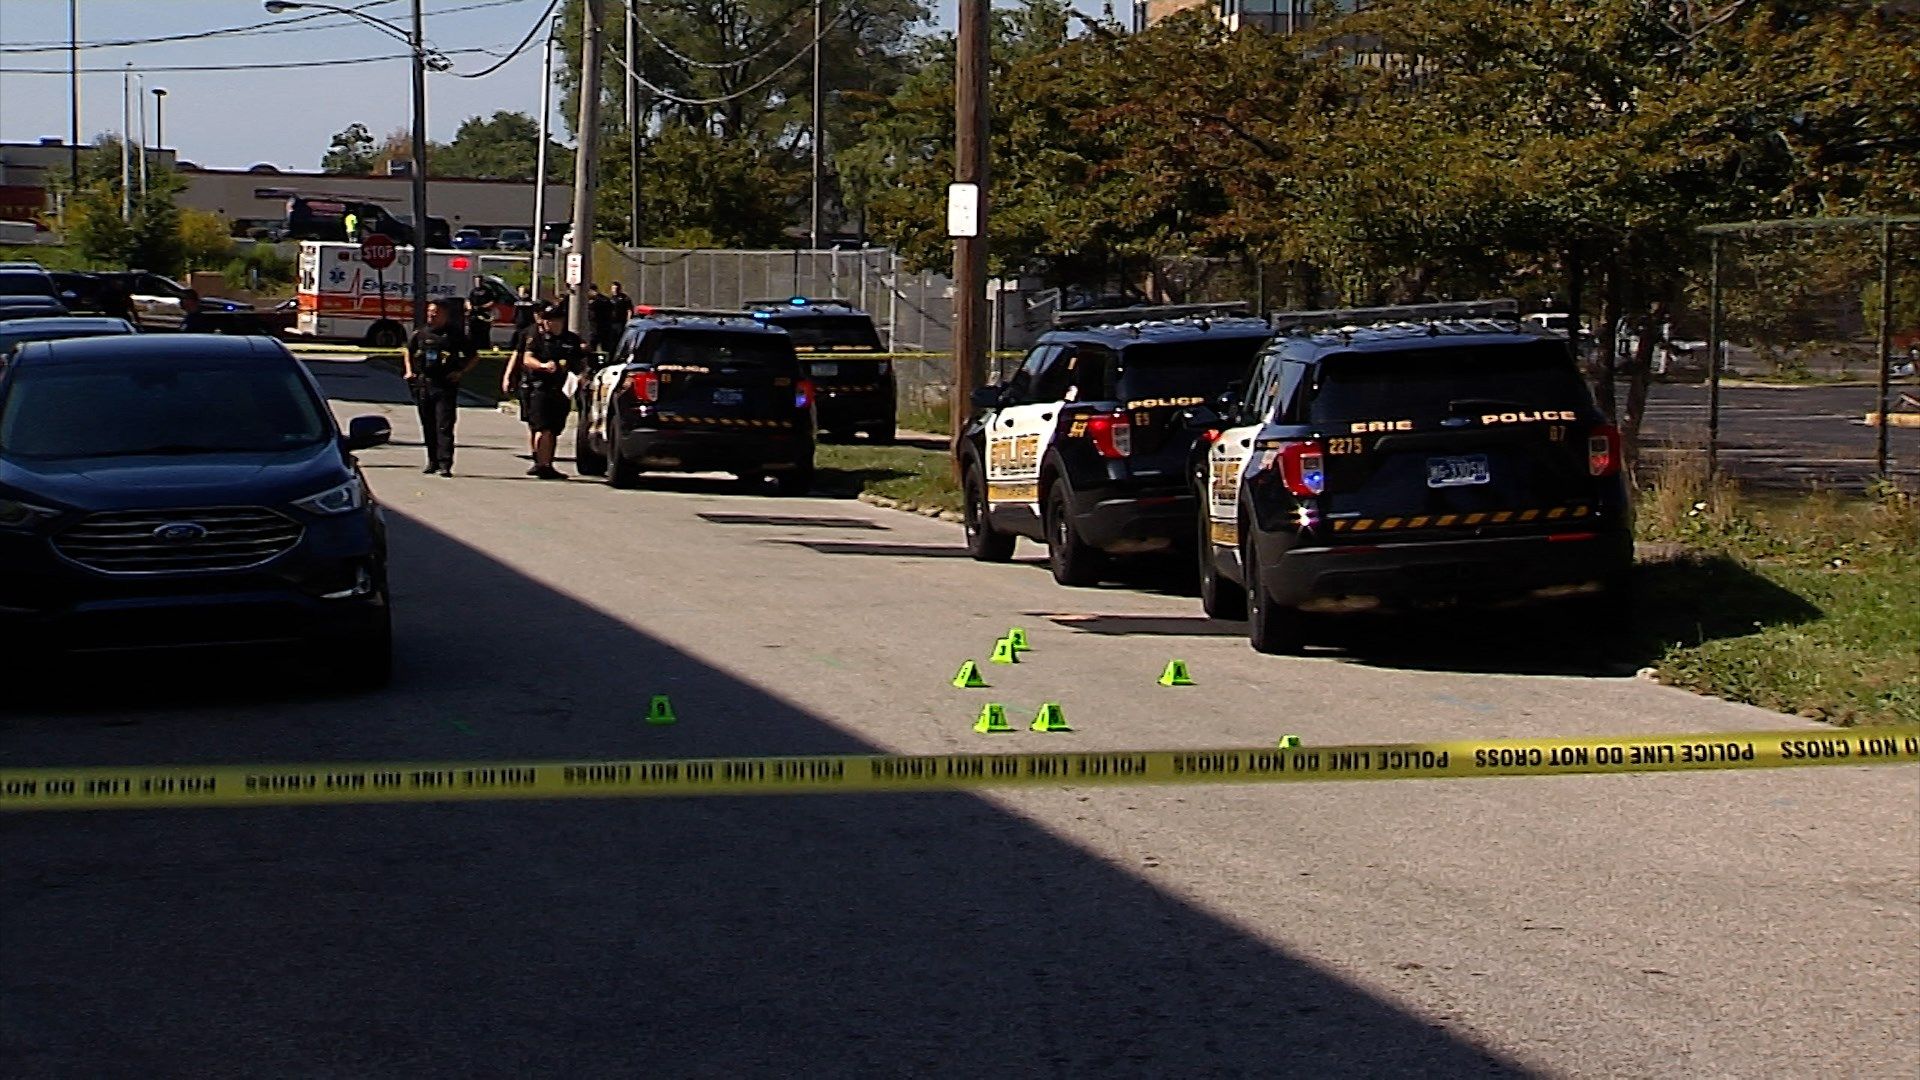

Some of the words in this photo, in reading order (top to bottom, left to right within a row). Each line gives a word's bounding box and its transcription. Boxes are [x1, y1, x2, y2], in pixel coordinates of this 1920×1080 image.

[363, 246, 394, 260] STOP
[1127, 397, 1205, 410] POLICE
[1350, 420, 1414, 434] ERIE
[1480, 411, 1577, 425] POLICE
[1595, 747, 1623, 765] DO
[1629, 745, 1675, 764] LINE
[1681, 743, 1755, 762] POLICE
[1780, 739, 1850, 759] CROSS
[1857, 737, 1898, 756] NOT
[1173, 754, 1239, 773] CROSS
[1246, 753, 1285, 772] NOT
[1293, 752, 1320, 771] DO
[1327, 752, 1369, 771] LINE
[1375, 751, 1448, 771] POLICE
[1475, 749, 1542, 768] CROSS
[1548, 747, 1588, 766] NOT
